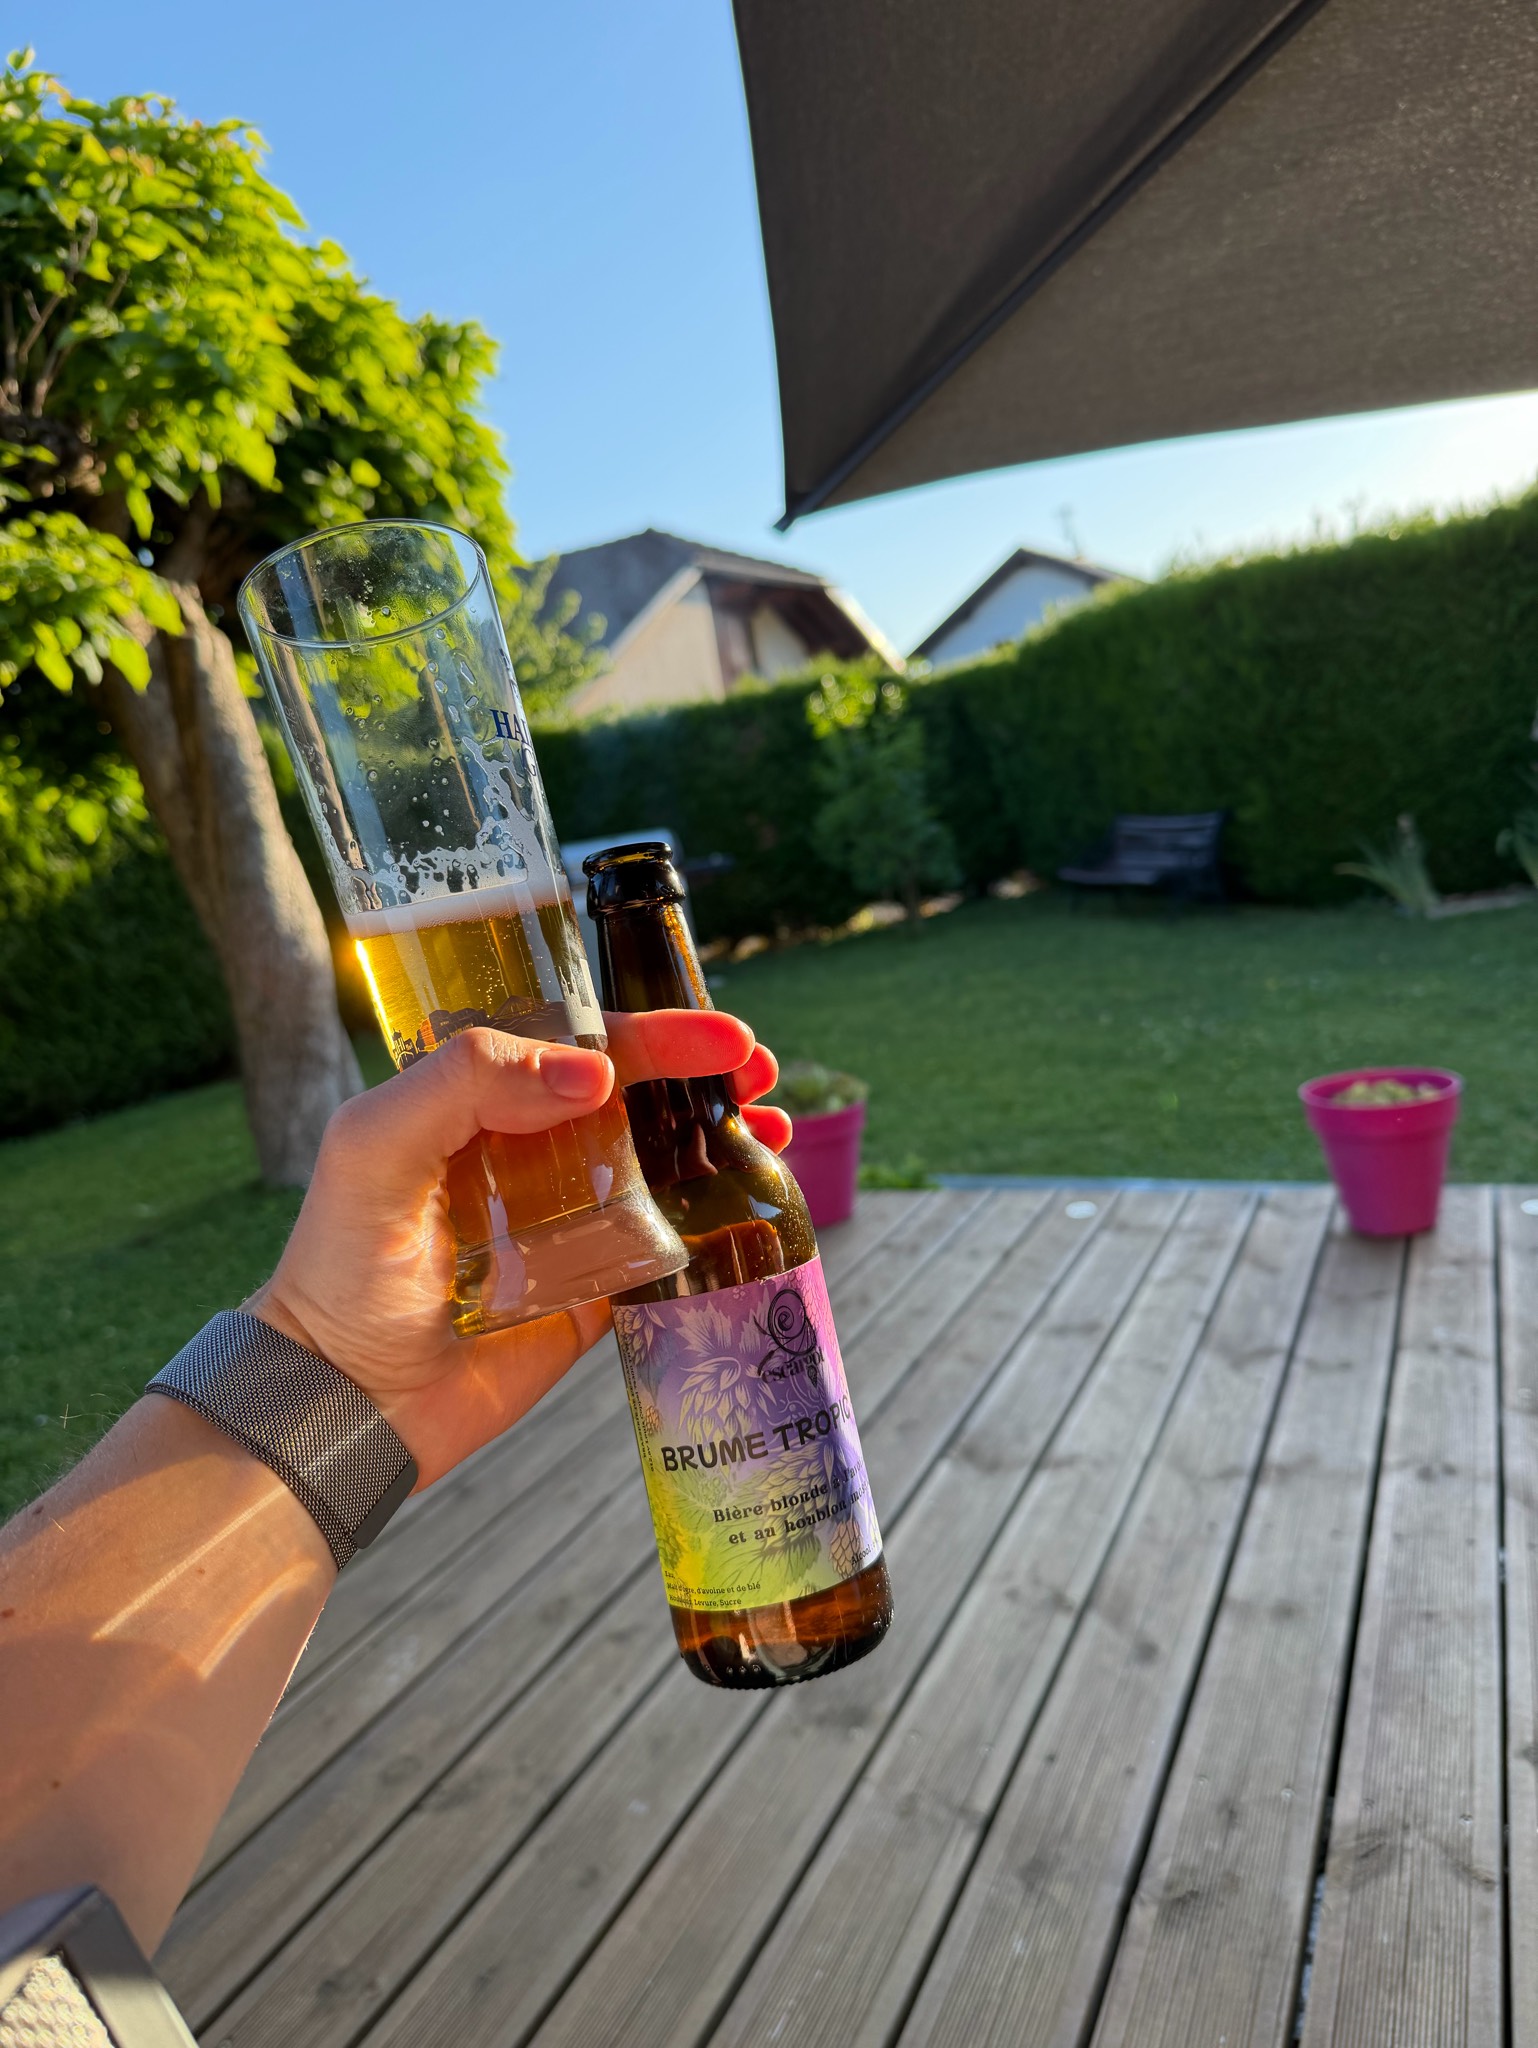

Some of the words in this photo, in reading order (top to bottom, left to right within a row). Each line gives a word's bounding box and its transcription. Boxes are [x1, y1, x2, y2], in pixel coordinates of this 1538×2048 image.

[660, 1431, 769, 1472] BRUME
[713, 1504, 763, 1523] Bière
[770, 1483, 829, 1513] blonde
[831, 1476, 841, 1490] à
[728, 1532, 747, 1545] et
[754, 1525, 777, 1540] au
[784, 1499, 848, 1534] houblon
[696, 1585, 726, 1595] d'avoine
[736, 1584, 747, 1593] de
[747, 1581, 762, 1591] blé
[719, 1597, 742, 1607] Sucre
